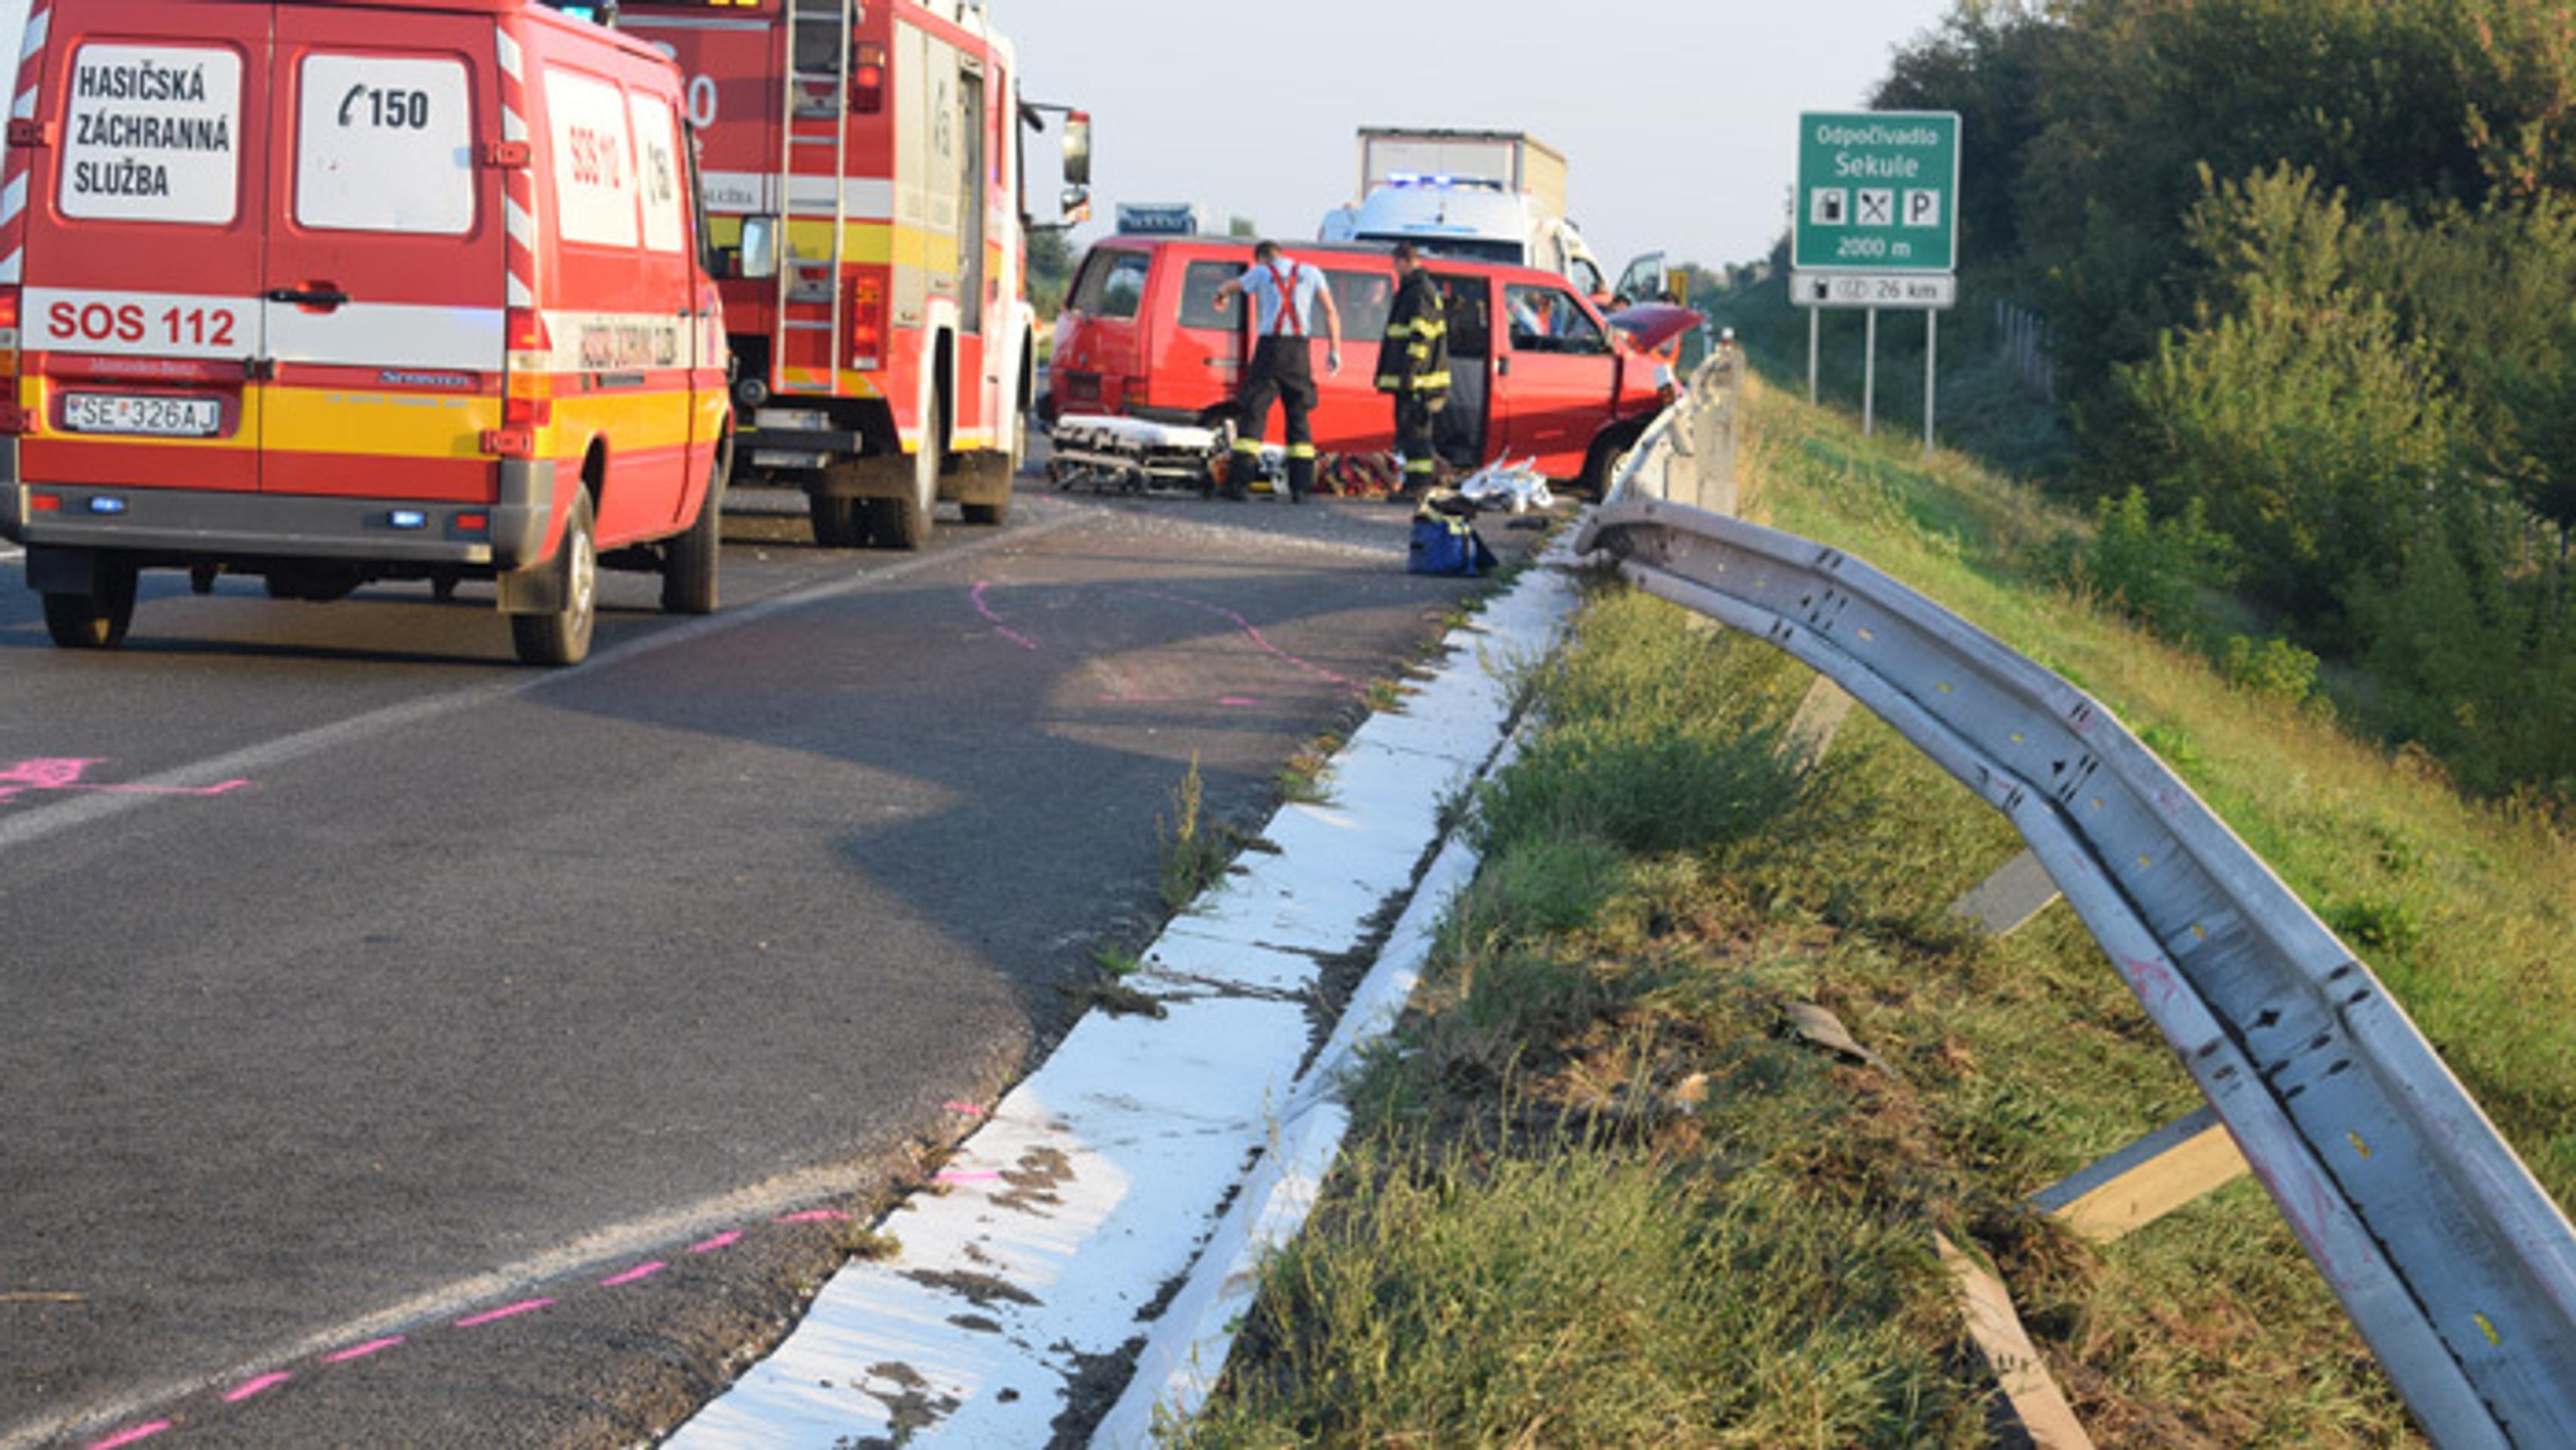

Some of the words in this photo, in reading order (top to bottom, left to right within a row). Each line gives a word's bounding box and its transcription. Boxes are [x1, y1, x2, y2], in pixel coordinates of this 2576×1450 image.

[79, 59, 204, 101] HASIČSKÁ
[369, 89, 428, 129] 150
[77, 107, 229, 151] ZÁCHRANNÁ
[74, 155, 169, 196] SLUŽBA
[1834, 151, 1919, 177] Sekule
[1911, 193, 1930, 222] P
[1836, 237, 1885, 257] 2000
[1890, 241, 1911, 257] m
[1877, 279, 1900, 298] 26
[1908, 281, 1937, 298] km
[48, 301, 145, 342] SOS
[162, 307, 236, 346] 112
[83, 397, 114, 425] SE
[131, 400, 217, 430] 326AJ
